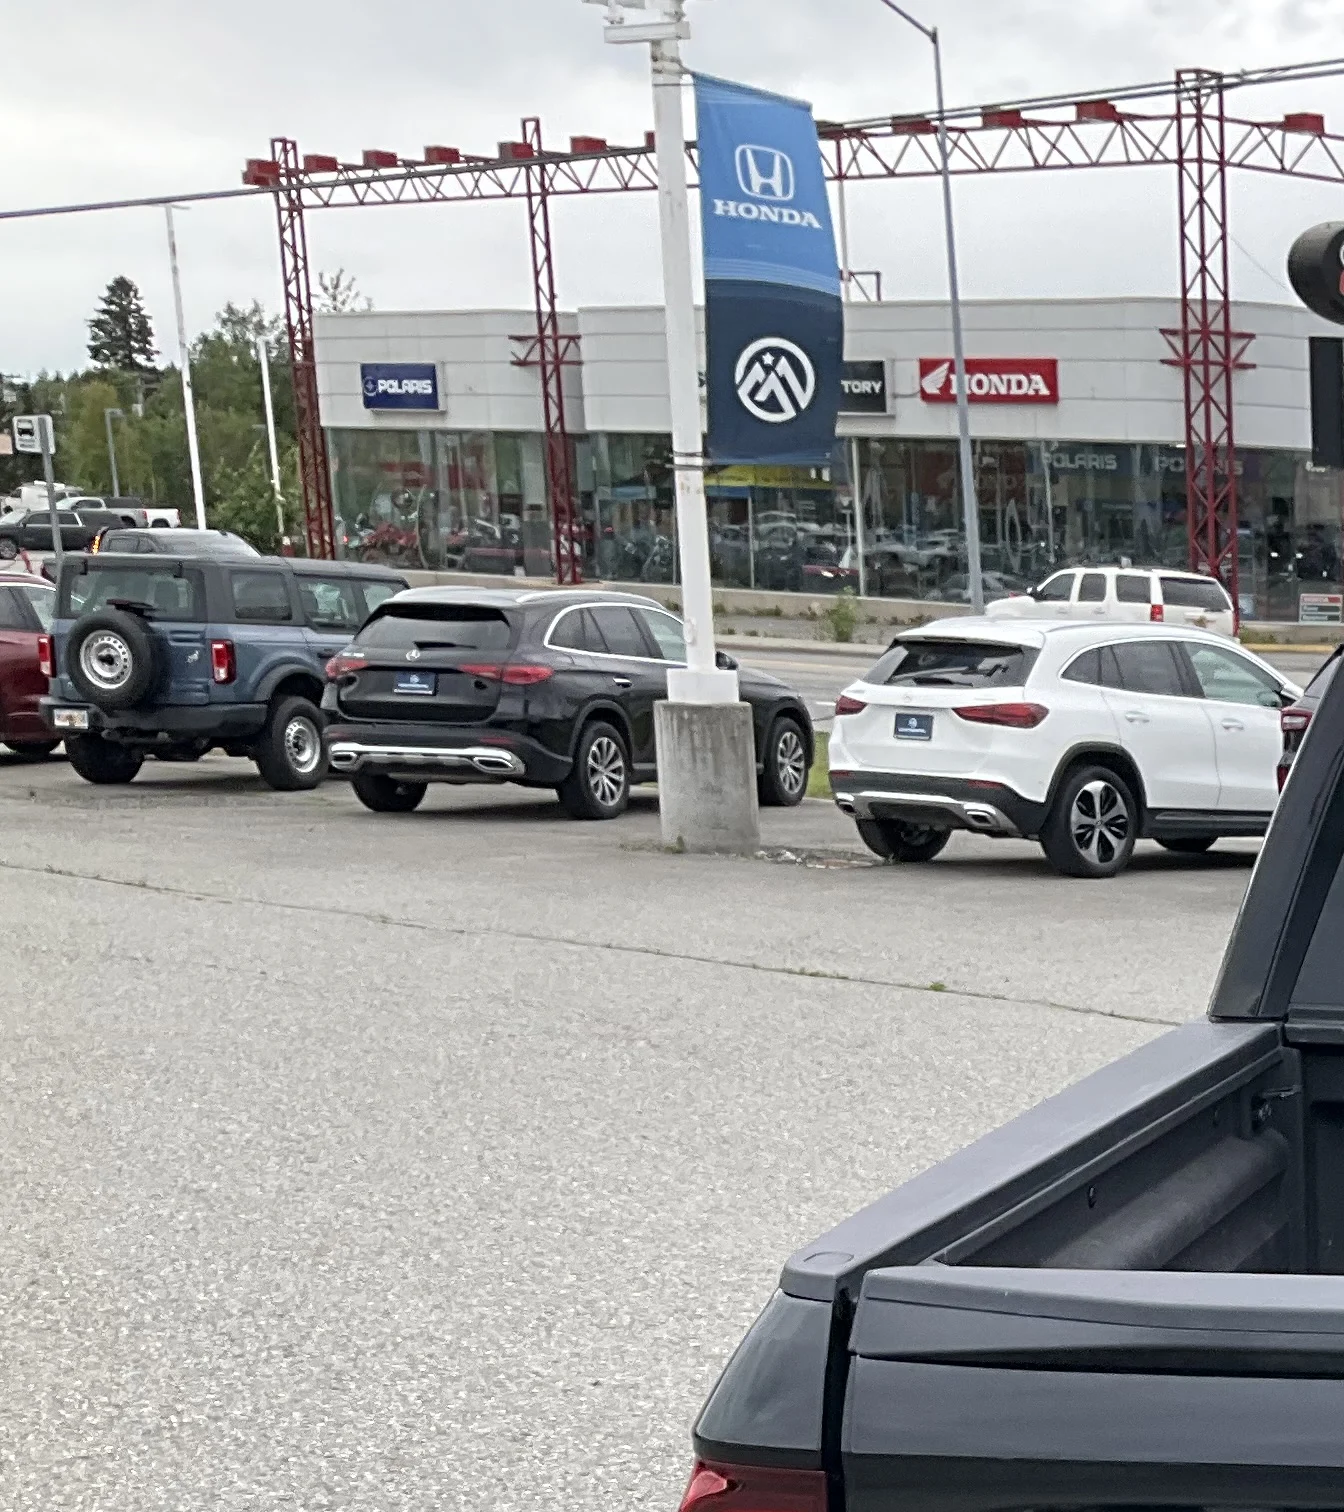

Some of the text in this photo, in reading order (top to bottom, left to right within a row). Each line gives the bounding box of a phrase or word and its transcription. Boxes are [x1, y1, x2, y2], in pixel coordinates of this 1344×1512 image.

[713, 199, 823, 230] HONDA
[377, 379, 433, 395] POLARIS
[950, 373, 1050, 396] HONDA
